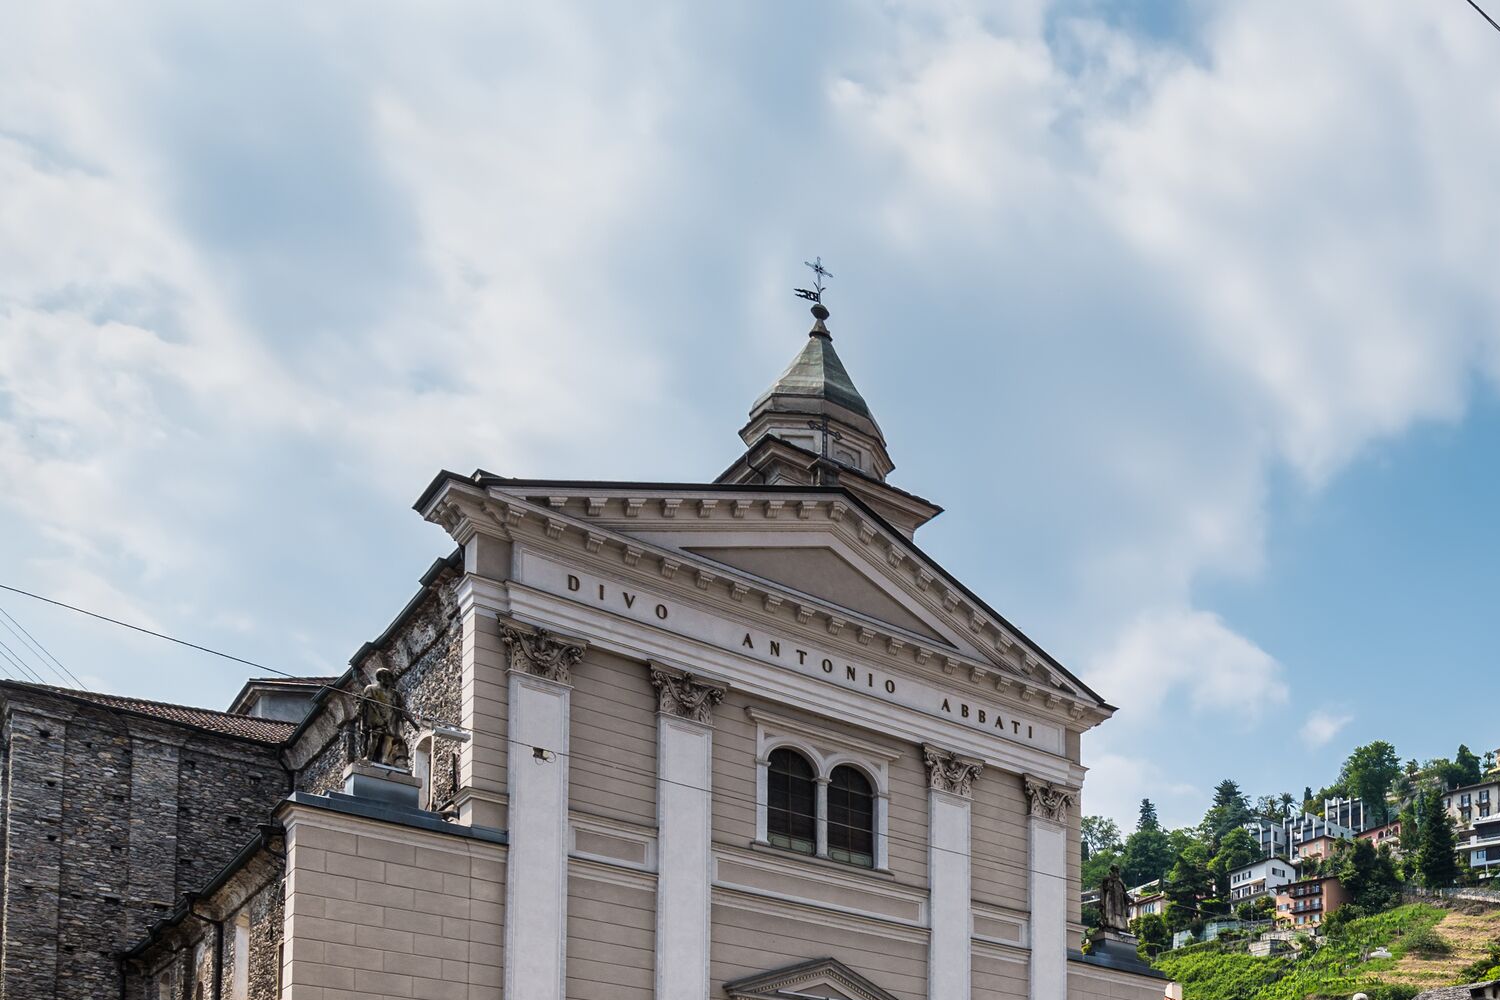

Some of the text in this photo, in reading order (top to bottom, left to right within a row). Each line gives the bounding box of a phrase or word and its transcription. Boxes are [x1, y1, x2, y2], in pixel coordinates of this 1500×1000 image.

[567, 574, 1034, 739] DIVO ANTONIO ABBATI
